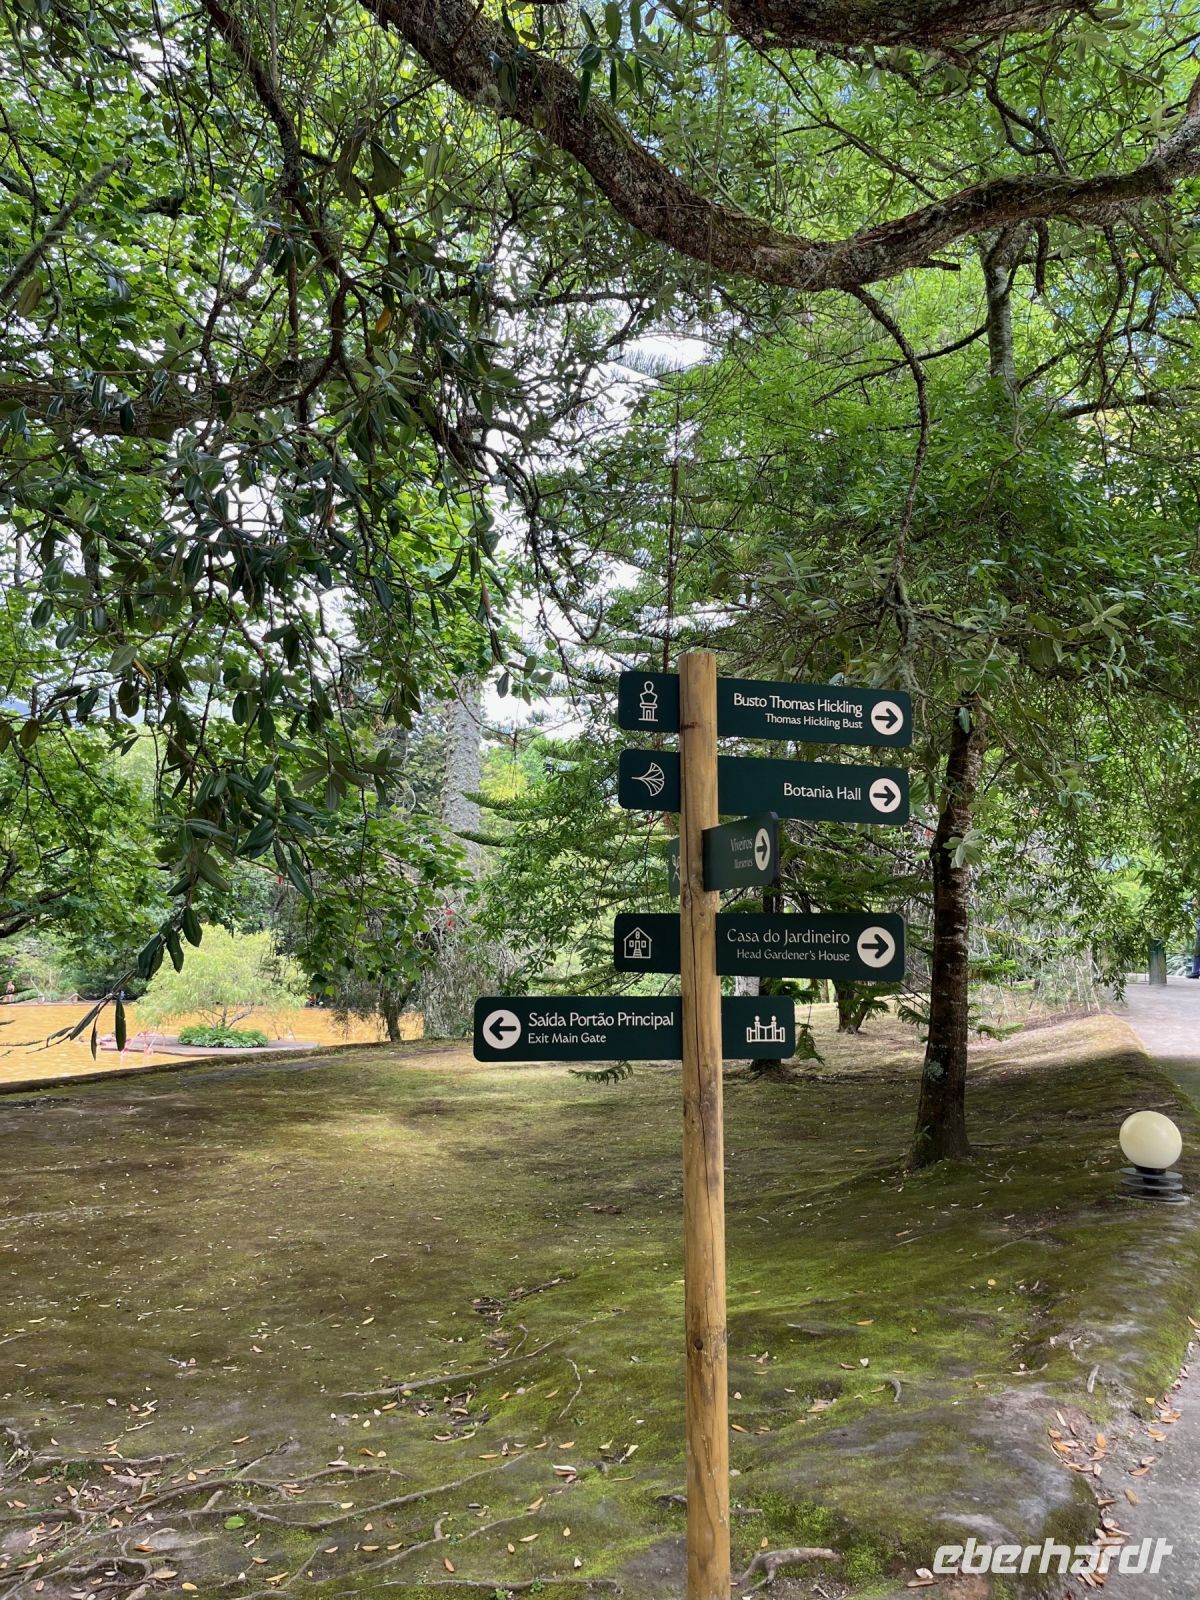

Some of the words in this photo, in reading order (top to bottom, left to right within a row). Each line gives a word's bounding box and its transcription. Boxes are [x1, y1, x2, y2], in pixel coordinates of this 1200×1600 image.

[733, 692, 768, 708] Busto
[770, 695, 816, 713] Thomas
[818, 699, 863, 718] Hickling
[765, 712, 801, 725] Thomas
[803, 714, 840, 731] Hickling
[842, 718, 863, 730] Bust
[783, 782, 834, 800] Botania
[836, 785, 861, 801] Hall
[727, 928, 759, 943] Casa
[762, 928, 781, 943] do
[784, 929, 850, 946] Jardineiro
[736, 948, 761, 960] Head
[764, 948, 816, 962] Gardener's
[818, 950, 850, 962] House
[528, 1012, 567, 1027] Saída
[570, 1012, 615, 1027] Portão
[617, 1011, 674, 1031] Principal
[528, 1032, 549, 1044] Exit
[552, 1032, 579, 1044] Main
[581, 1032, 607, 1043] Gate
